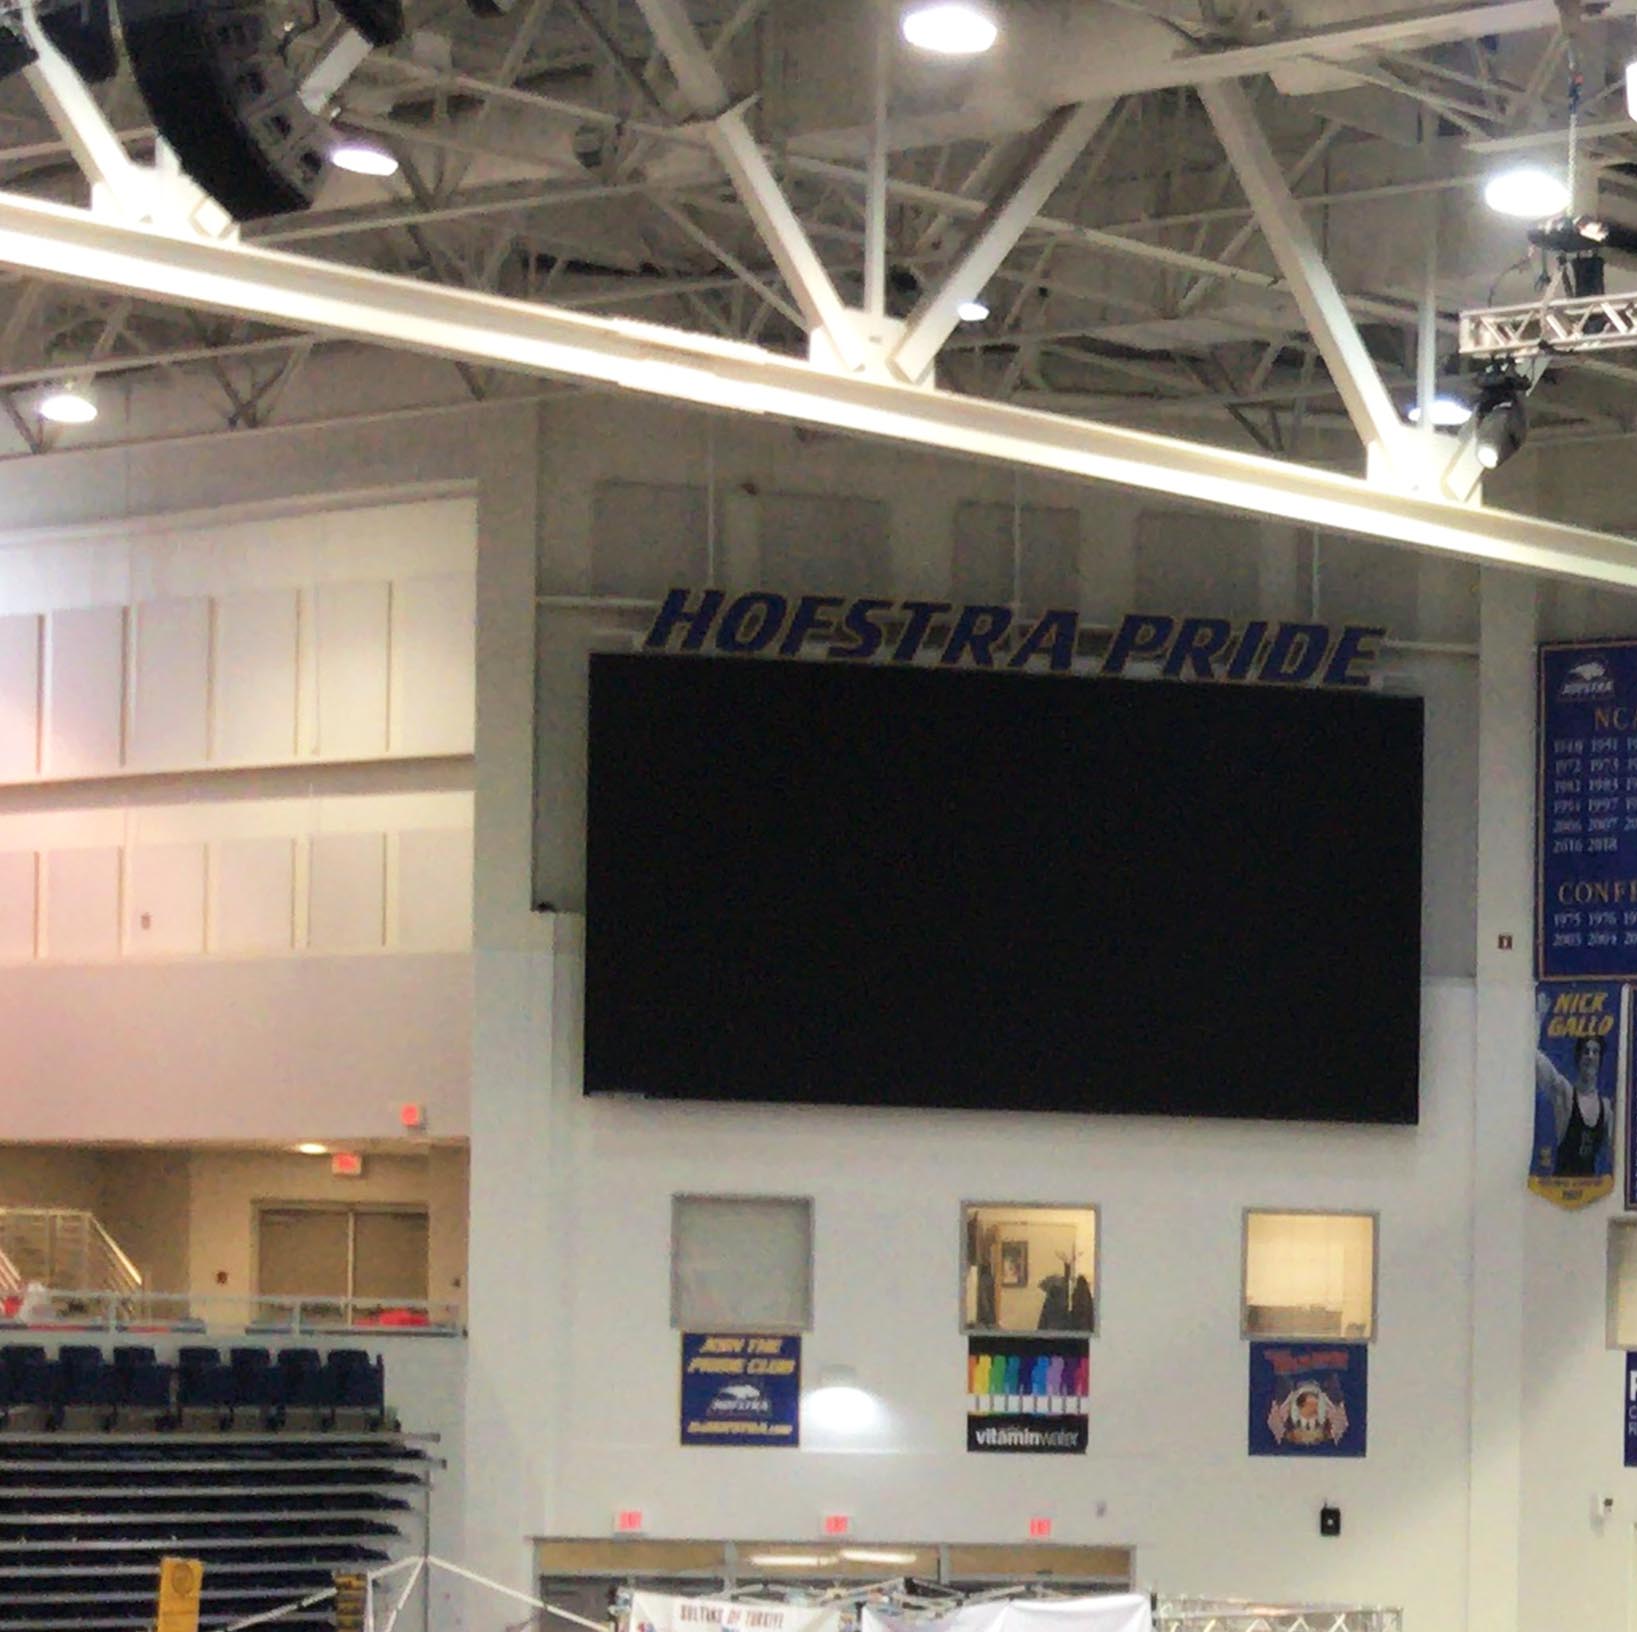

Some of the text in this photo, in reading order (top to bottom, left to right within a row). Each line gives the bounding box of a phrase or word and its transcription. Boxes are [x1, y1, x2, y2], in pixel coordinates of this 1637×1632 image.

[641, 587, 1388, 688] HOFSTRA PRIDE
[1554, 993, 1608, 1014] NICK
[1547, 1015, 1614, 1037] GALLO
